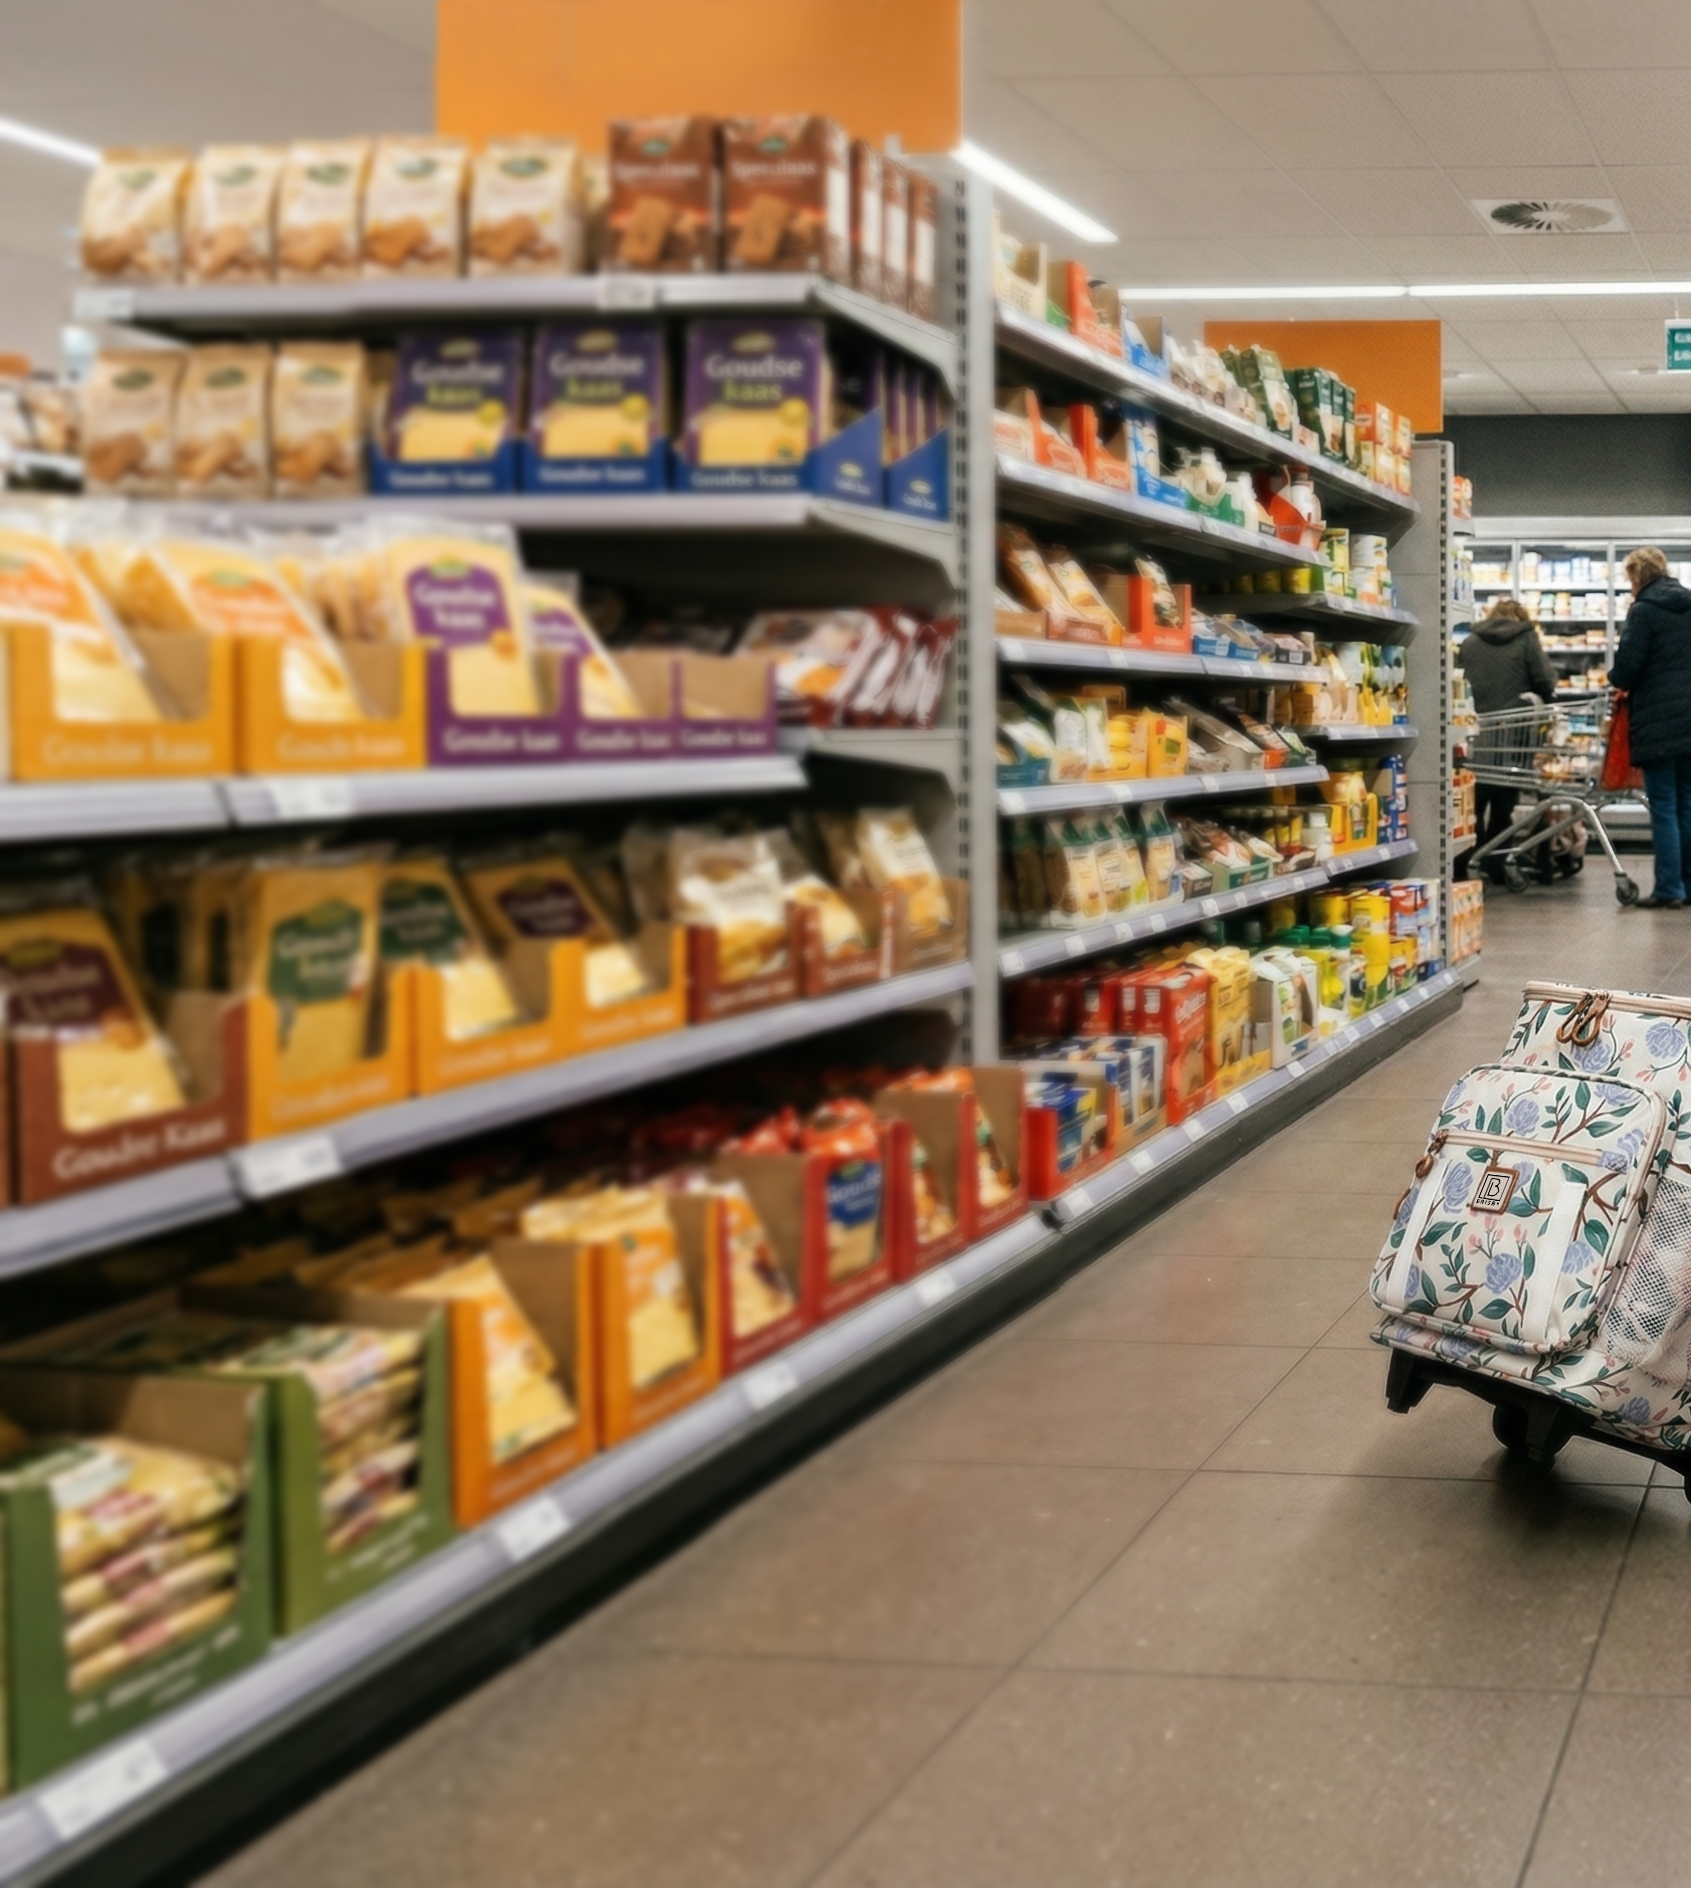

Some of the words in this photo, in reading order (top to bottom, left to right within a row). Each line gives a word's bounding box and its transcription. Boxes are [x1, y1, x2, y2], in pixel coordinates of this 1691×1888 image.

[614, 160, 699, 182] Speculaas
[731, 158, 817, 180] Speculaas
[410, 358, 505, 384] Goudse
[548, 352, 646, 376] Goudse
[705, 353, 803, 378] Goudse
[426, 380, 483, 403] kaas
[566, 376, 624, 399] kaas
[724, 379, 782, 400] kaas
[538, 463, 600, 483] Goudse
[605, 463, 646, 484] kaas
[690, 471, 755, 487] Goudse
[759, 471, 798, 487] kaas
[681, 727, 735, 746] Goudse
[738, 726, 767, 746] kaas
